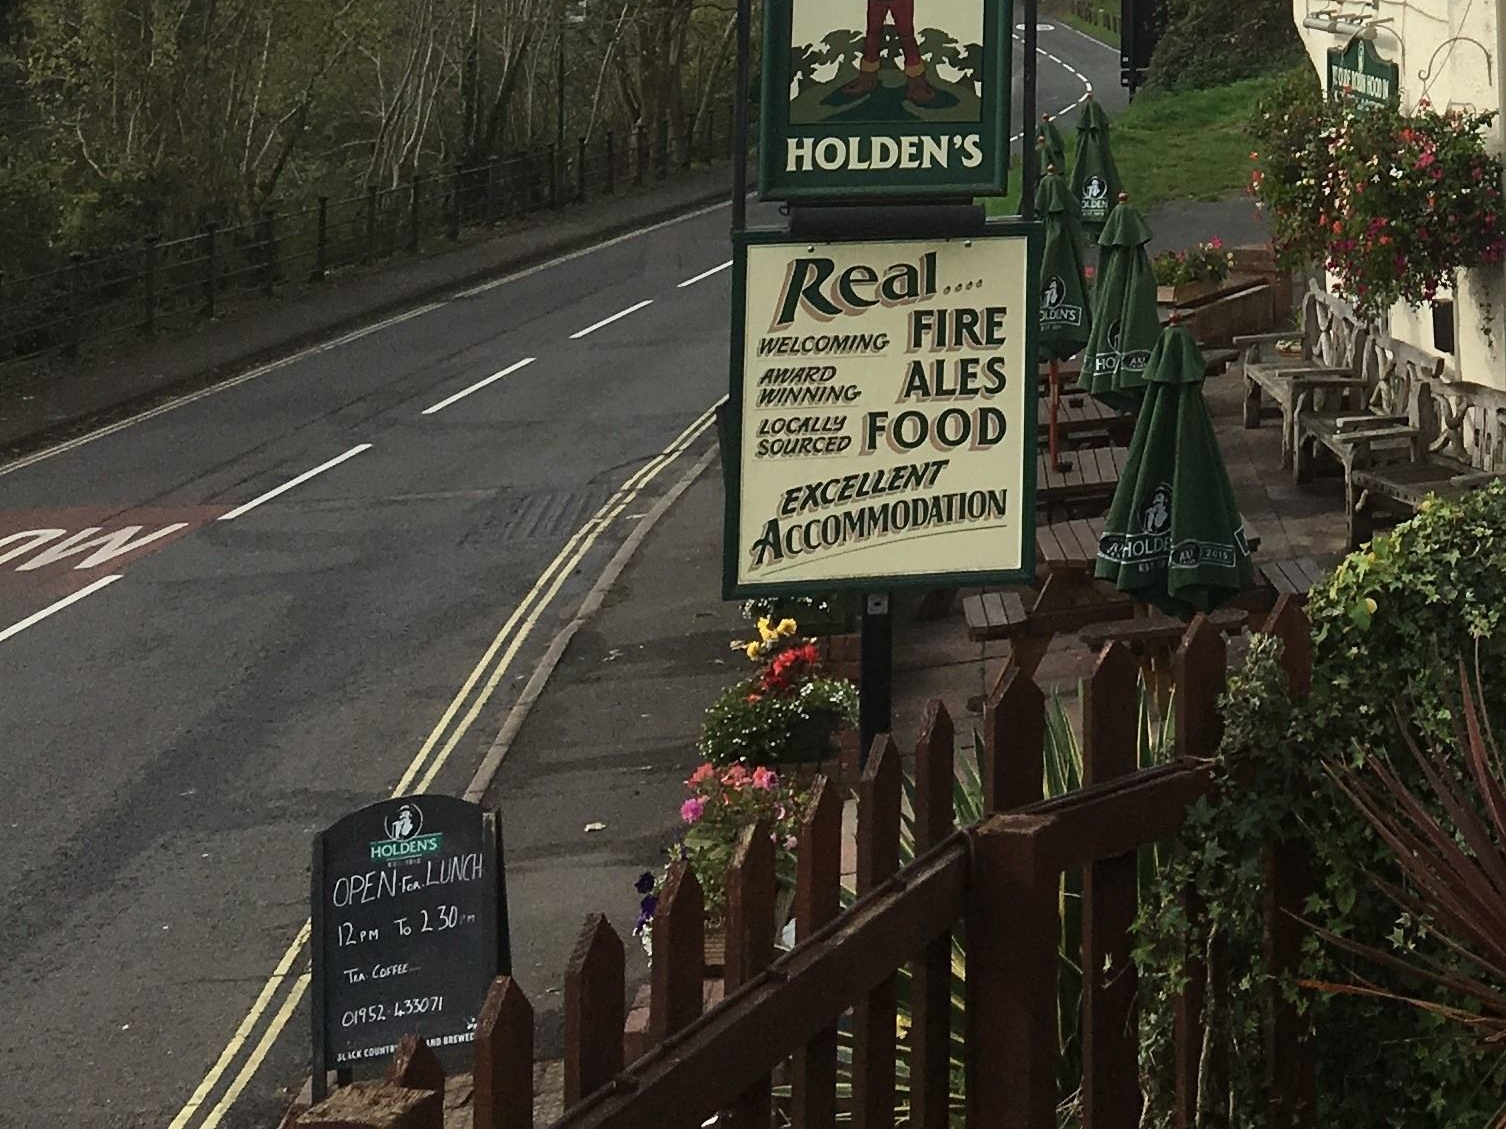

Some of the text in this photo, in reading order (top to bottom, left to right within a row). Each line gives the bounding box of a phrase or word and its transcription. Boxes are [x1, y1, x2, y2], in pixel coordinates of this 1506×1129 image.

[786, 134, 984, 173] HOLDEN'S
[905, 306, 1008, 353] FIRE
[1039, 307, 1077, 322] OLDEN'S
[757, 333, 890, 356] WELCOMING
[759, 365, 837, 386] AWARD
[897, 356, 1008, 402] ALES
[757, 385, 862, 406] WINNING
[757, 414, 848, 437] LOCALLY
[860, 406, 1008, 454] FOOD
[756, 435, 852, 458] SOURCED
[780, 459, 951, 517] EXCELLENT
[750, 488, 1008, 568] ACCOMMODATION
[371, 837, 439, 859] HOLDEN'S
[333, 869, 396, 907] OPEN
[426, 853, 484, 885] LUNCH
